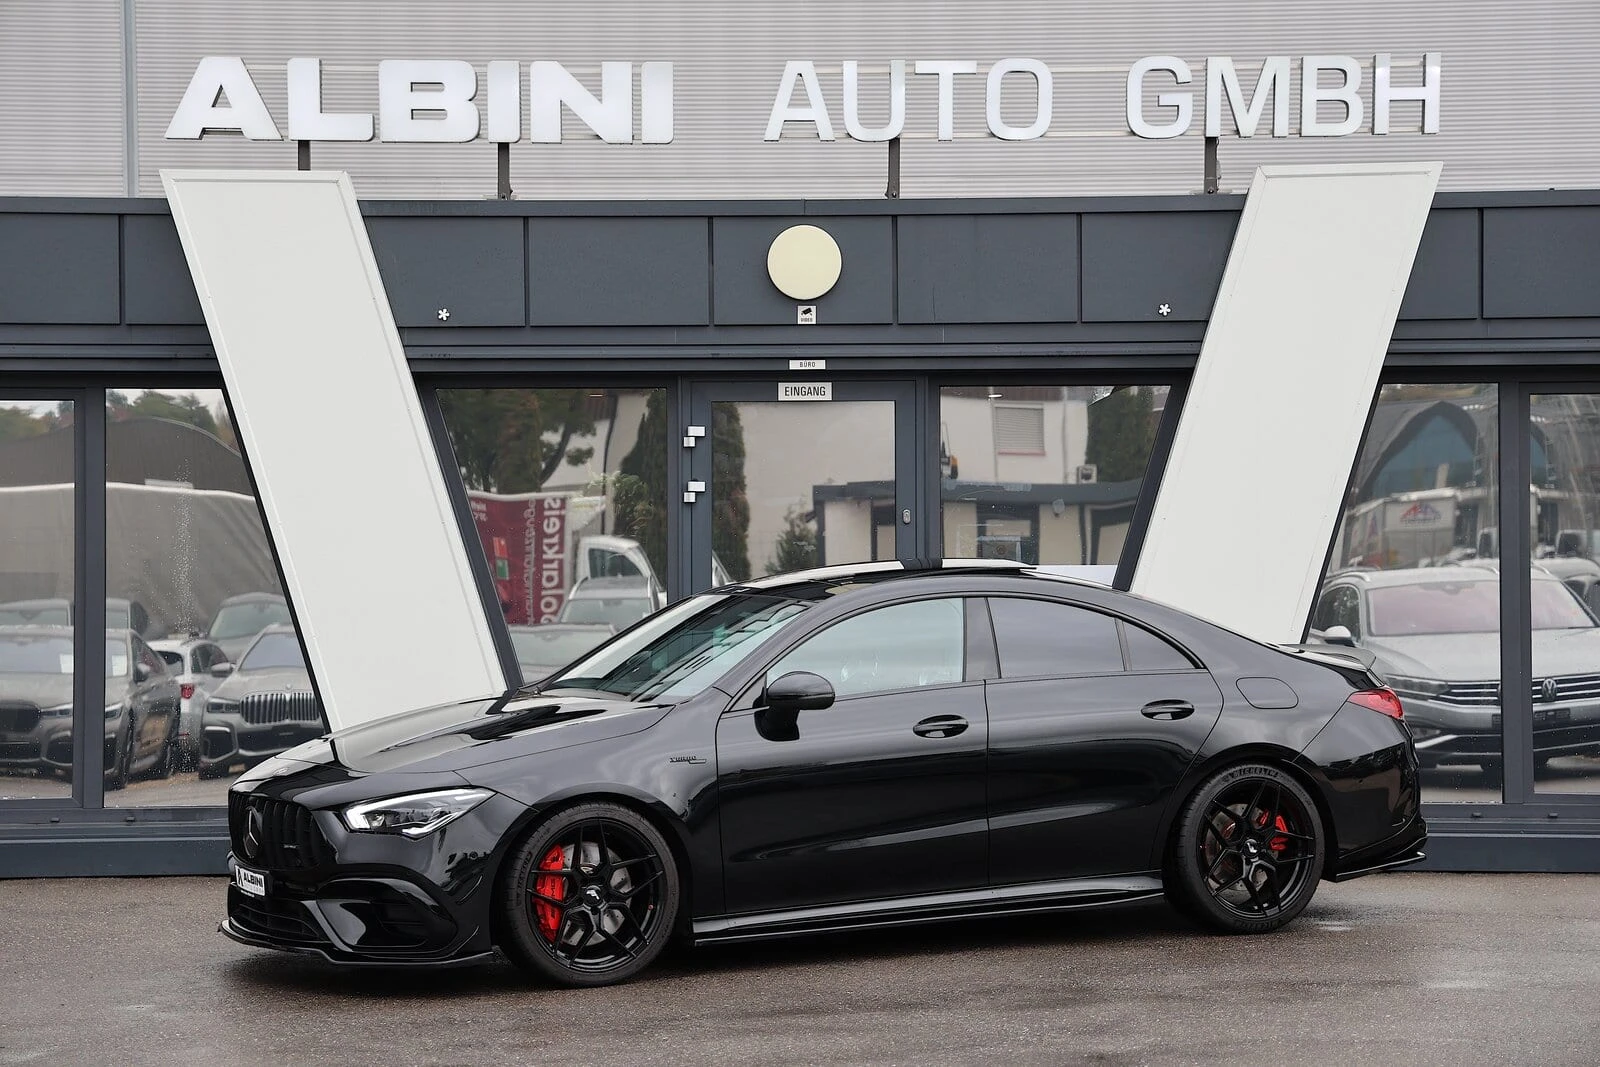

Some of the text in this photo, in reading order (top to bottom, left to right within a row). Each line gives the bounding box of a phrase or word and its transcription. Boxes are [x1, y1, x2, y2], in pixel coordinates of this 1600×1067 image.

[164, 52, 1442, 145] ALBINI AUTO GMBH
[799, 360, 816, 368] BÜRO
[784, 386, 826, 397] EINGANG
